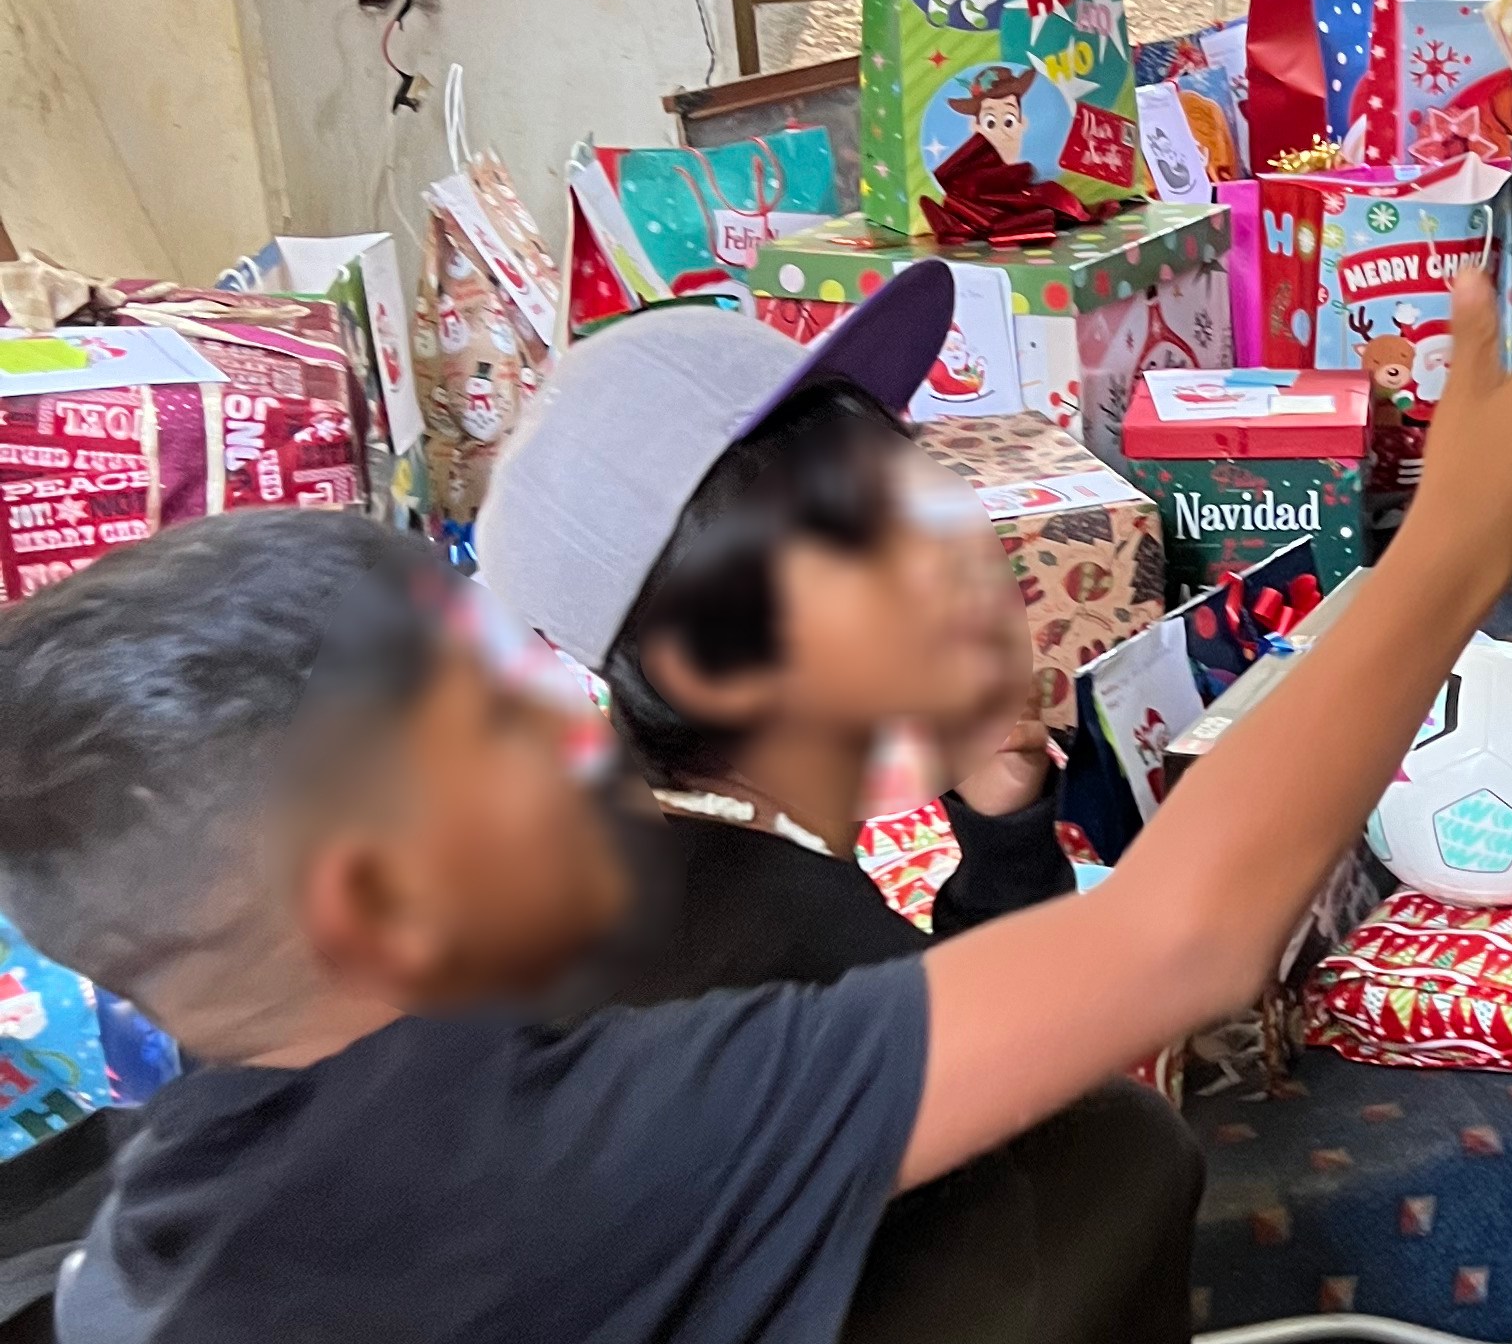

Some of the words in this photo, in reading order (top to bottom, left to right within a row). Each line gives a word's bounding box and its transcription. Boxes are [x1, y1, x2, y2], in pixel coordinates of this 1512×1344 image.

[1045, 41, 1094, 84] HO
[1343, 255, 1419, 293] MERRY
[1, 470, 151, 502] PEACE
[1173, 489, 1322, 540] Navidad
